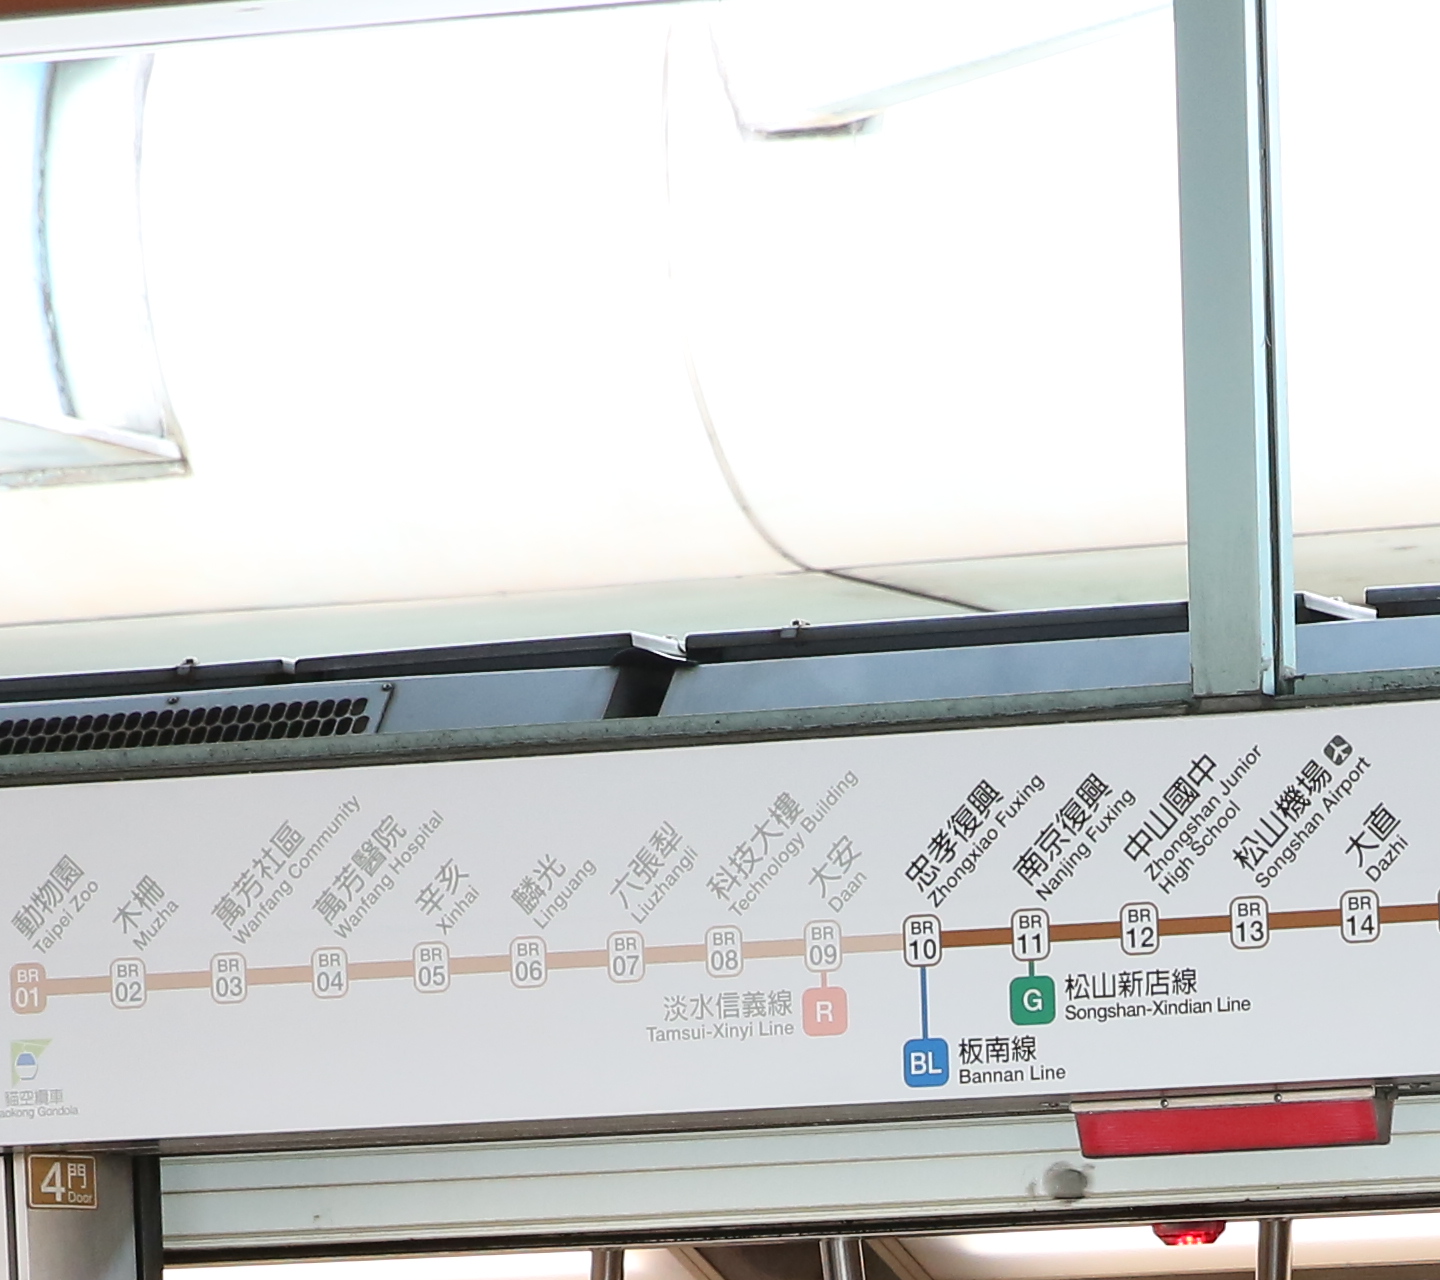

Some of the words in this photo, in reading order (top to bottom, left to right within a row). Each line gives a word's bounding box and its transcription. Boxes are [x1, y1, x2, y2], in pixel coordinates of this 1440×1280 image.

[1011, 771, 1110, 887] 南京復興
[1122, 752, 1217, 862] 中山國中
[1142, 795, 1221, 882] Zhongshan
[1218, 743, 1261, 796] Junior
[1231, 758, 1333, 872] 松山機場
[1254, 811, 1325, 887] Songshan
[1321, 756, 1371, 814] Airport
[727, 831, 804, 916] Technology
[799, 769, 858, 833] Building
[903, 778, 1001, 893] 忠孝復興
[925, 827, 999, 909] Zhongxiao
[993, 773, 1045, 828] Fuxing
[1034, 841, 1092, 900] Nanjing
[1084, 788, 1137, 843] Fuxing
[1156, 856, 1195, 895] High
[1189, 798, 1241, 857] School
[1343, 800, 1402, 868] 大直
[1364, 832, 1409, 883] Dazhi
[231, 879, 293, 944] Wanfang
[287, 795, 360, 879] Community
[333, 873, 395, 938] Wanfang
[387, 809, 444, 875] Hospital
[532, 859, 597, 928] Linguang
[630, 844, 698, 922] Liuzhangli
[827, 871, 867, 913] Daan
[31, 910, 74, 952] Taipei
[68, 880, 98, 913] Zoo
[131, 900, 179, 949] Muzha
[435, 886, 479, 933] Xinhai
[909, 938, 937, 961] 10
[1017, 932, 1041, 955] 11
[663, 990, 793, 1021] 淡水信義線
[1024, 991, 1042, 1011] G
[1064, 969, 1198, 1000] 松山新店線
[1065, 1000, 1210, 1022] Songshan-Xindian
[1217, 997, 1251, 1013] Line
[647, 1023, 752, 1042] Tamsui-Xinyi
[759, 1021, 794, 1037] Line
[816, 1002, 832, 1021] R
[911, 1053, 941, 1074] BL
[959, 1036, 1036, 1064] 板南線
[960, 1067, 1023, 1084] Bannan
[1030, 1065, 1065, 1081] Line
[41, 1162, 65, 1202] 4
[68, 1163, 86, 1189] 門
[68, 1192, 92, 1203] Door
